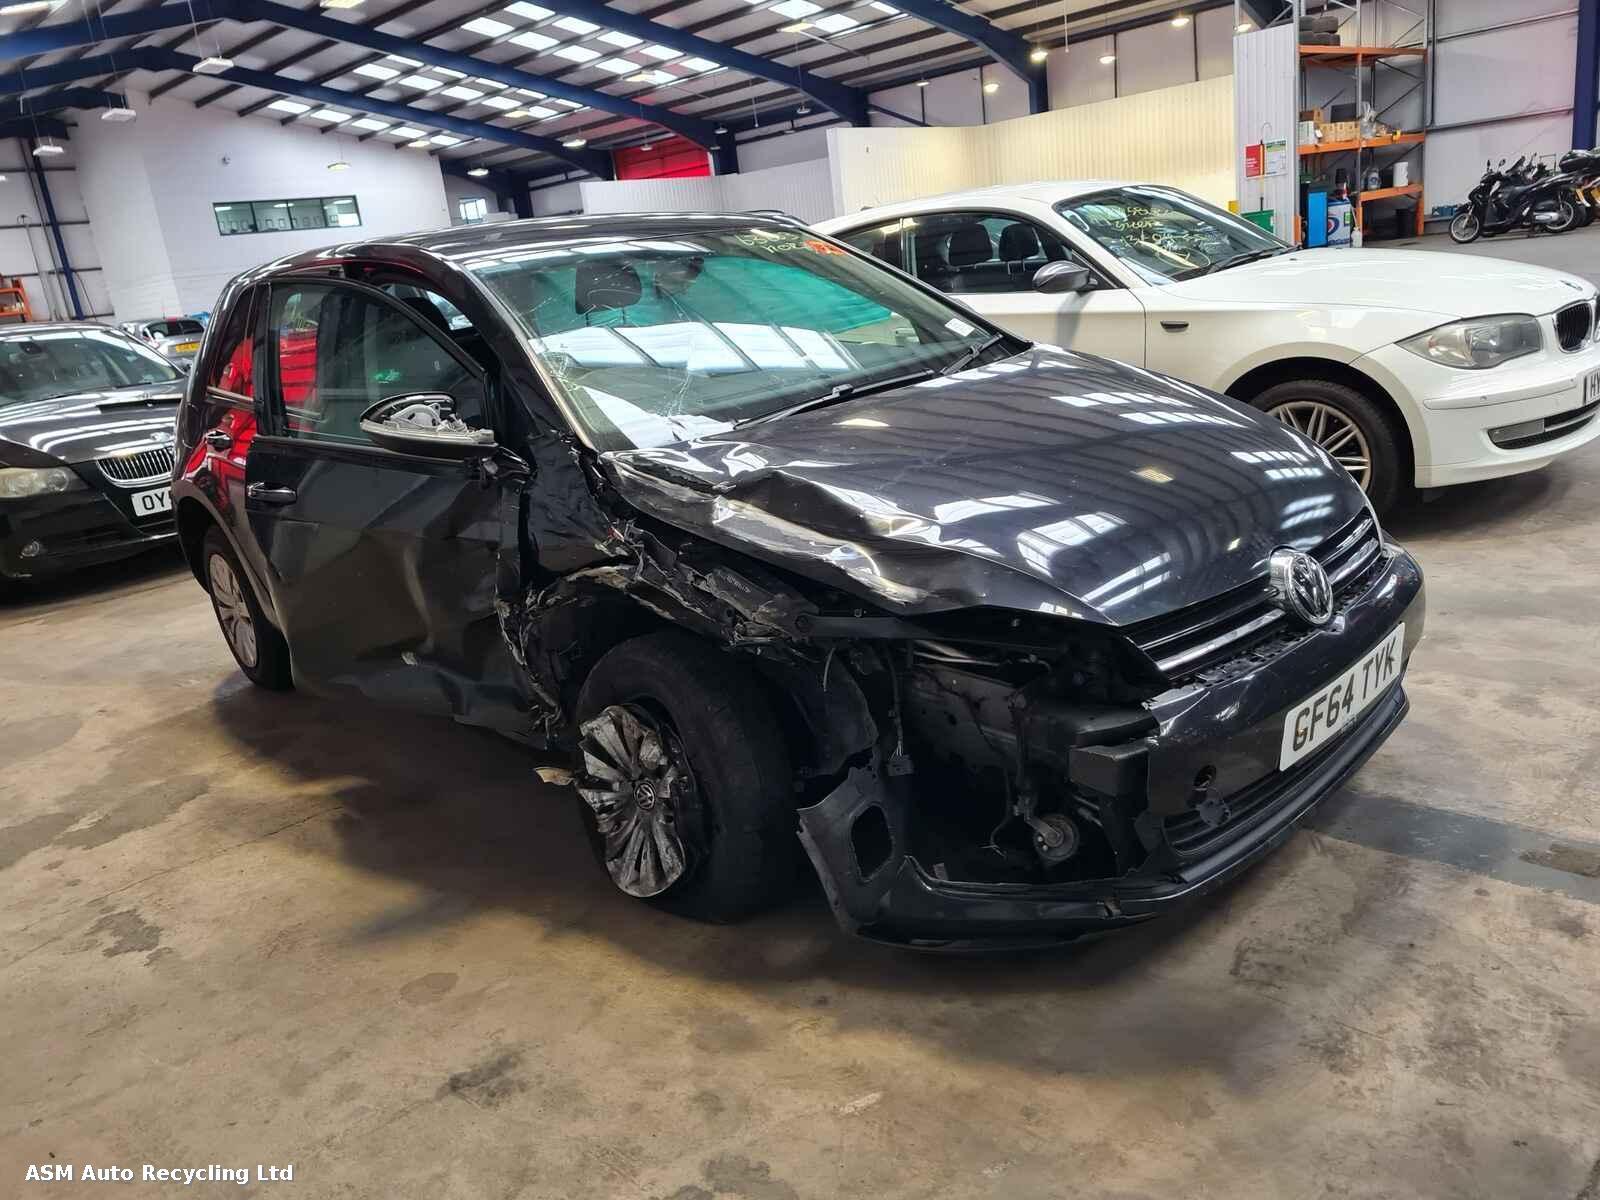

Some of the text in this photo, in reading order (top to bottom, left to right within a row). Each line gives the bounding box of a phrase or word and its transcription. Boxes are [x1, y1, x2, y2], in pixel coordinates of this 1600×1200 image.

[142, 490, 172, 510] OY
[1293, 636, 1396, 752] GF64 TYK
